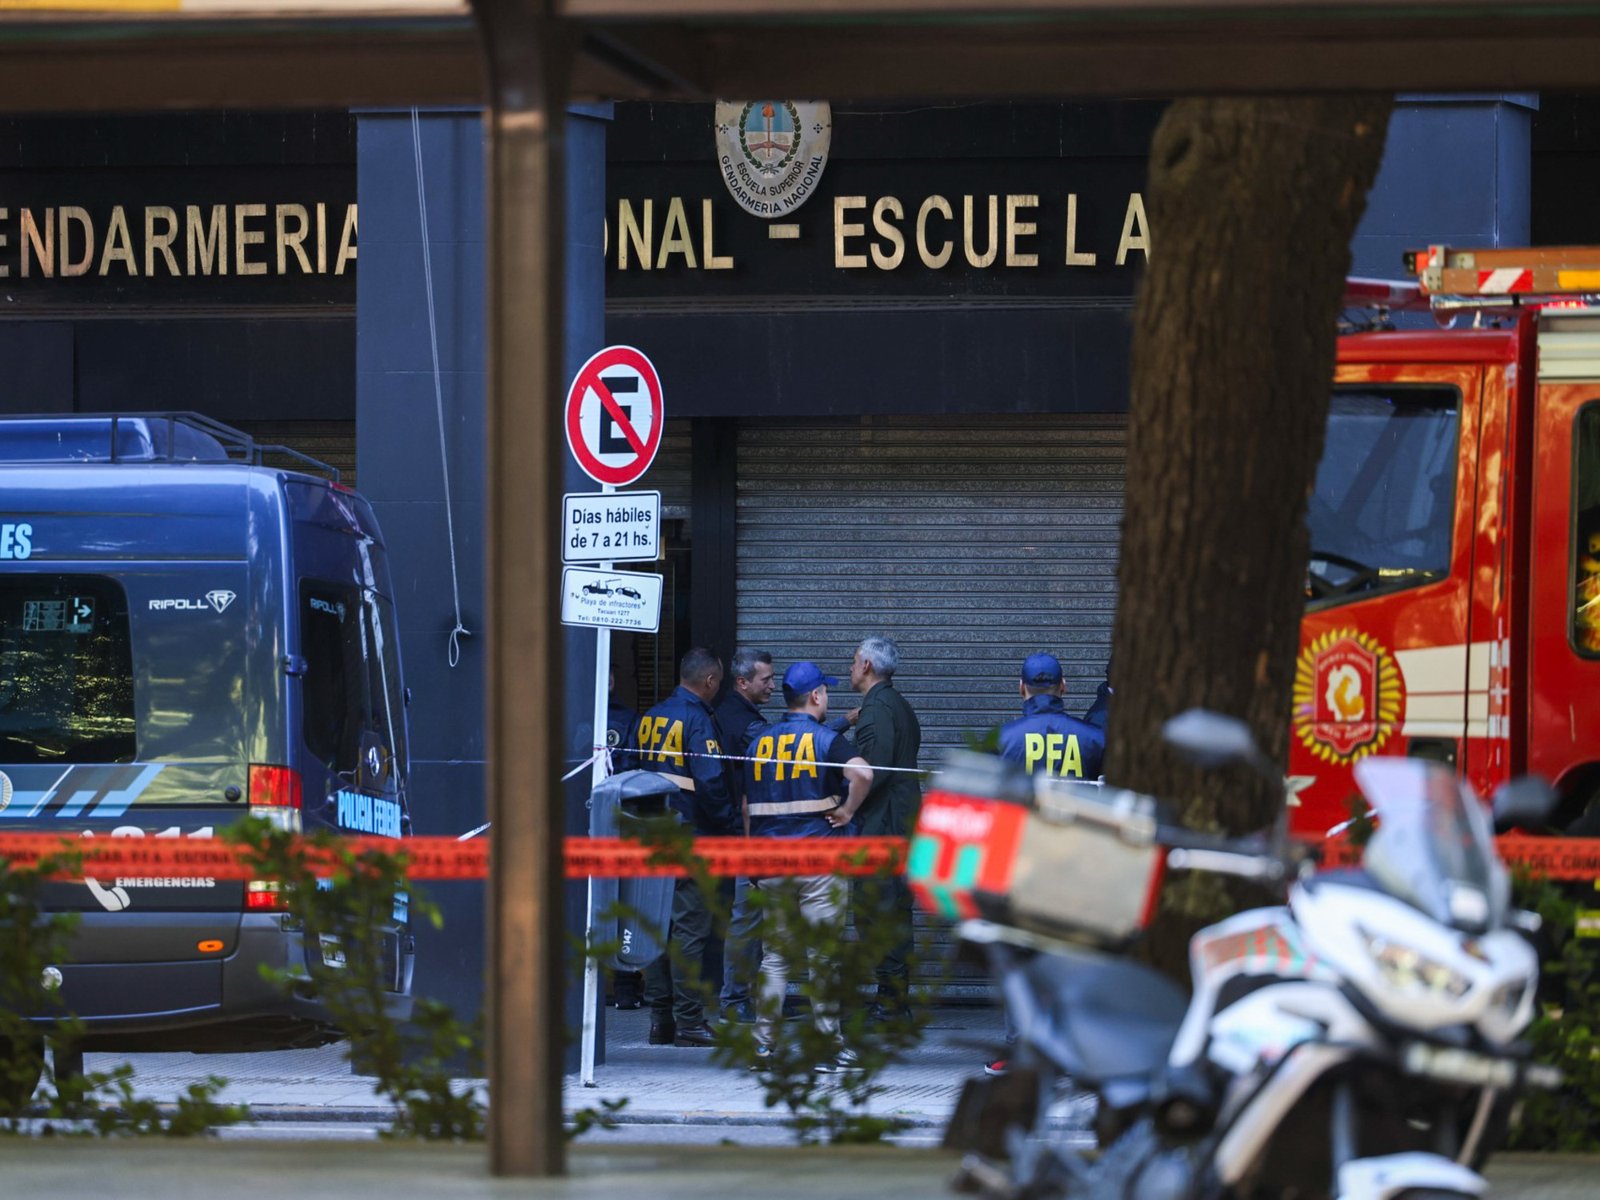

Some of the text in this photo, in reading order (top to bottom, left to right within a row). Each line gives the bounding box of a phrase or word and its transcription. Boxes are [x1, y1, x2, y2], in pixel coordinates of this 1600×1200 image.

[721, 155, 823, 213] GENDARMERIA NACIONAL
[737, 160, 805, 196] ESCUELA SUPERIOR
[0, 203, 357, 278] NDARMERIA
[604, 197, 734, 270] NAL
[572, 508, 602, 524] Días
[606, 507, 652, 523] hábiles
[0, 523, 33, 559] ES
[570, 531, 652, 548] de 7 a 21 hs.
[149, 599, 208, 610] RIPOLL
[580, 597, 596, 605] Playa
[609, 600, 640, 609] infractores
[638, 716, 685, 767] PFA
[754, 733, 818, 782] PFA
[1025, 733, 1083, 778] PFA
[115, 877, 216, 888] EMERGENCIAS
